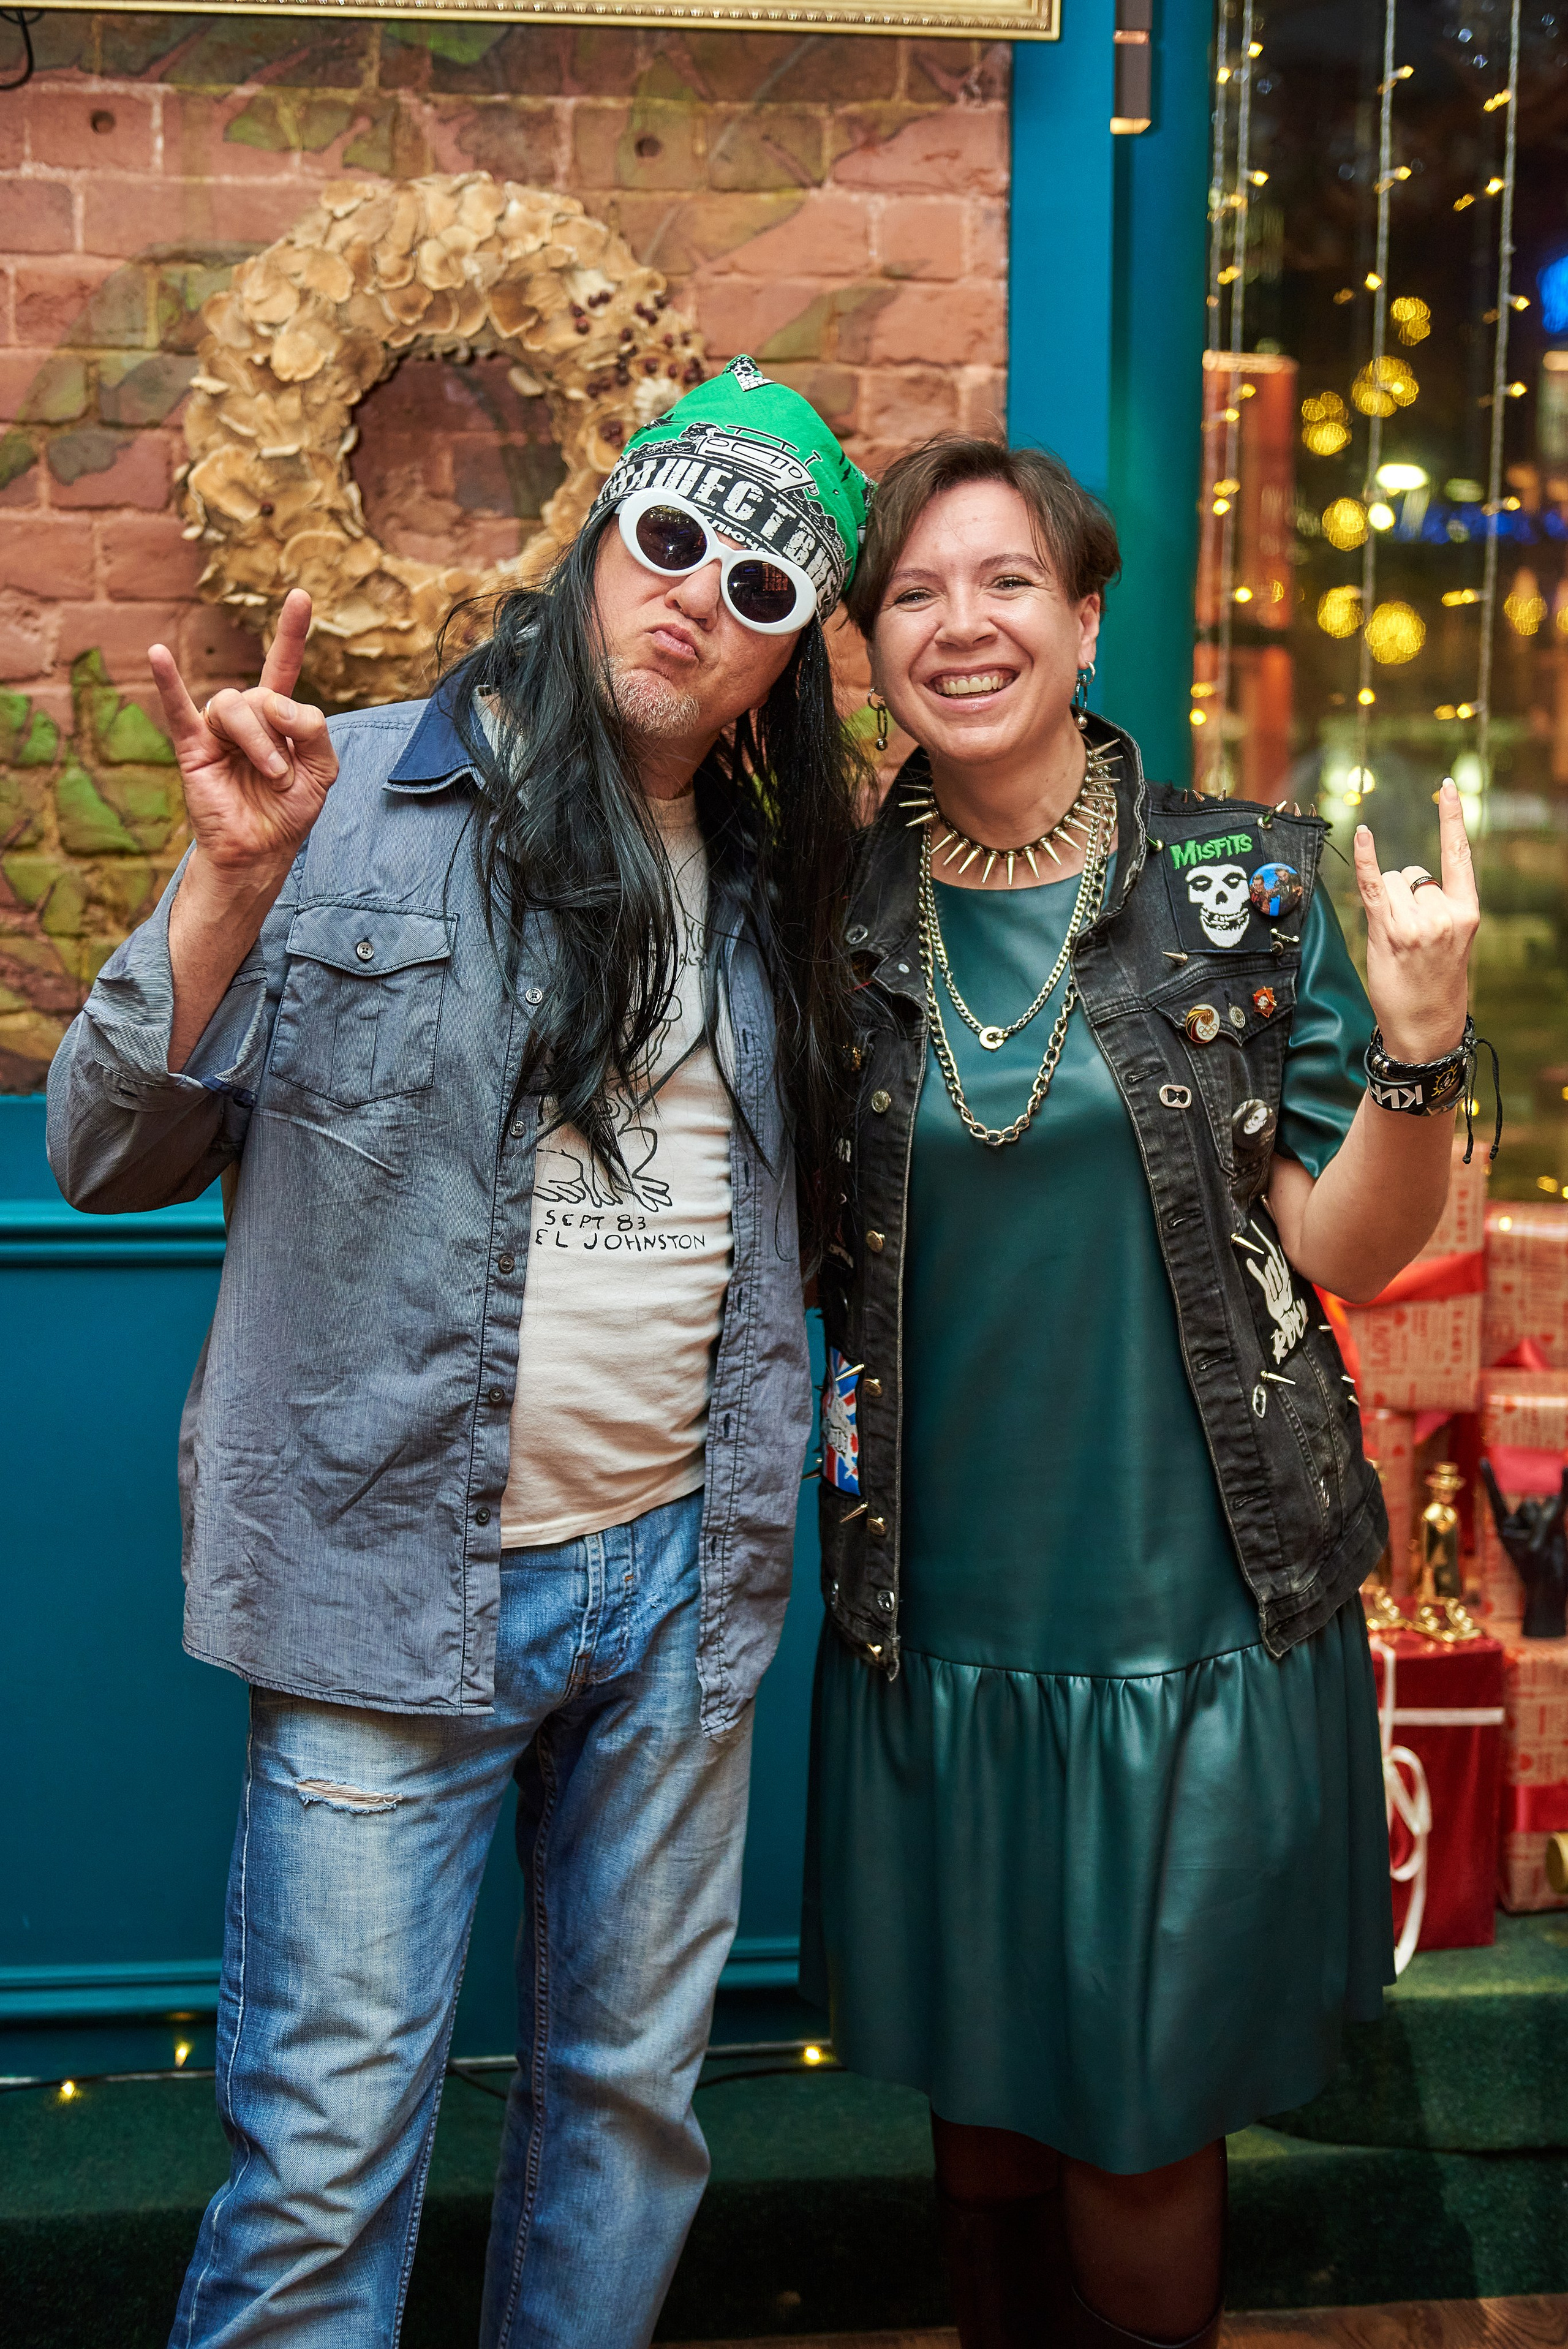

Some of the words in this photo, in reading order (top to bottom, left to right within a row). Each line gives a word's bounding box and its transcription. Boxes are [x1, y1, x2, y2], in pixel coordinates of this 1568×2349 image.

[545, 1209, 605, 1230] SEPT
[617, 1213, 646, 1232] 83
[584, 1232, 706, 1251] JOHNSTON
